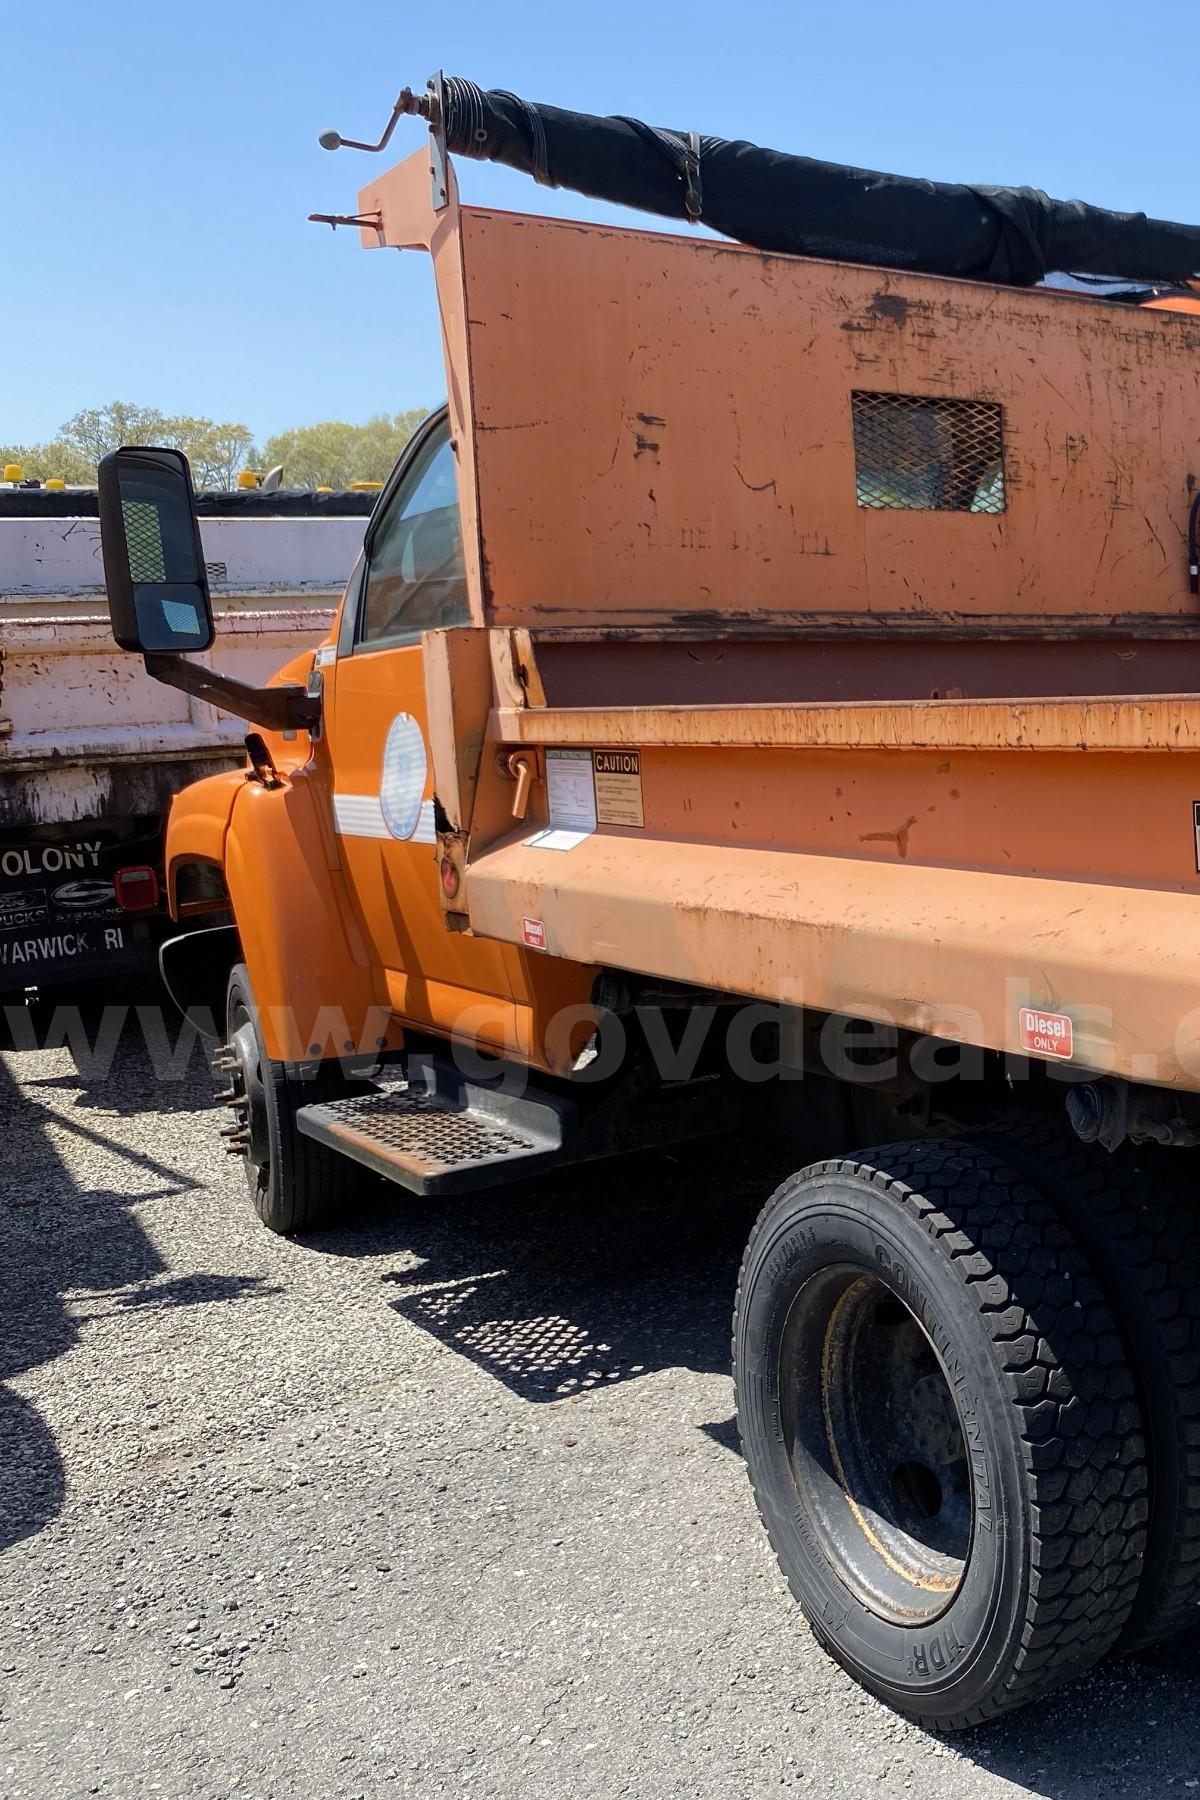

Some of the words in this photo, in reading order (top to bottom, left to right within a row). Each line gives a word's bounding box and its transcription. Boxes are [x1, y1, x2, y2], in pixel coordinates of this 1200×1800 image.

[595, 755, 639, 773] CAUTION
[1, 841, 102, 877] OLONY
[103, 927, 124, 950] RI
[1026, 1013, 1066, 1038] Diesel
[1033, 1036, 1059, 1052] ONLY
[873, 1243, 992, 1534] CONTINENTAL
